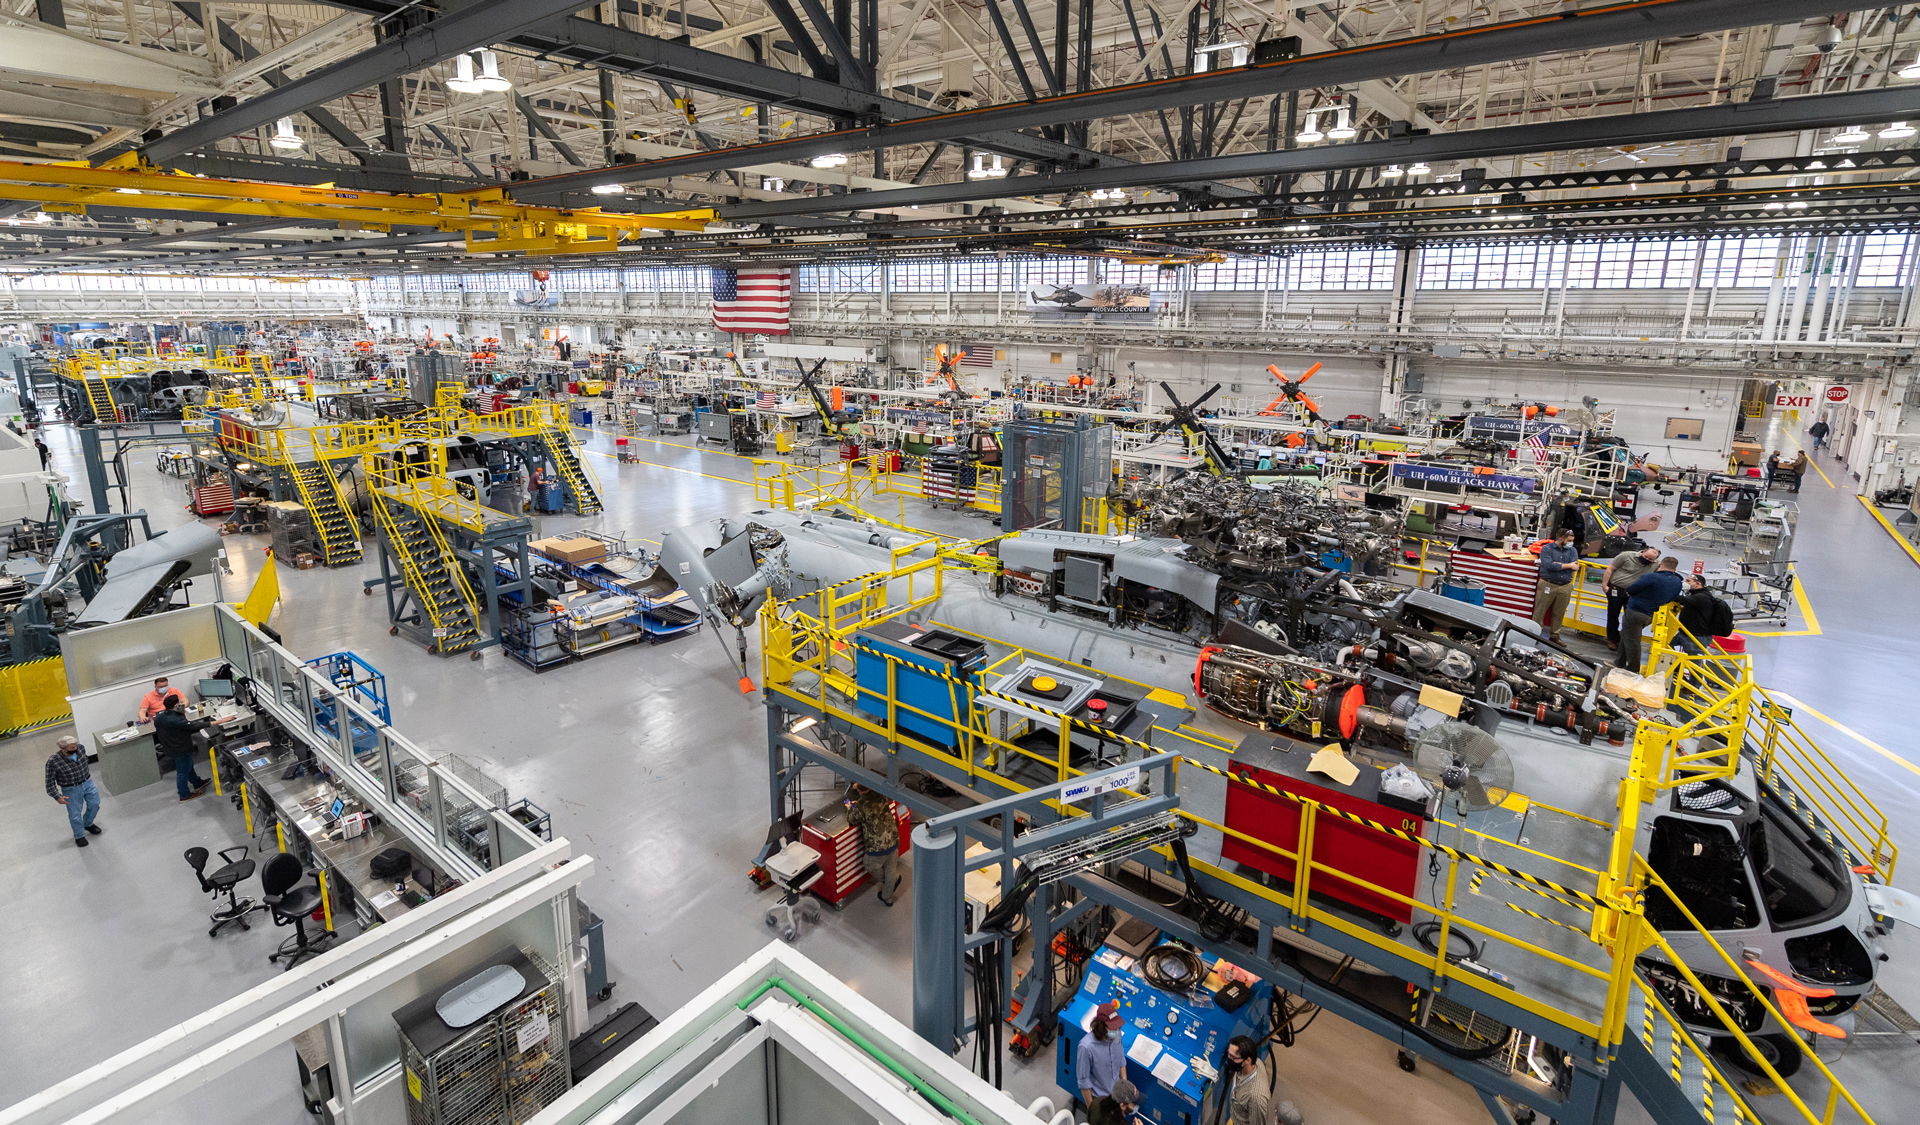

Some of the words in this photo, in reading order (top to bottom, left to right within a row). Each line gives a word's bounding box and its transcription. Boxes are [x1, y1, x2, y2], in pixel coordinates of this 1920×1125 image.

[1827, 390, 1848, 398] STOP
[1776, 395, 1813, 407] EXIT
[1515, 424, 1540, 432] BACK
[1410, 471, 1448, 483] UH-60M
[1450, 475, 1485, 487] BLACK
[1487, 480, 1521, 491] HAWK
[1110, 777, 1129, 789] 1000
[1401, 818, 1416, 832] 04
